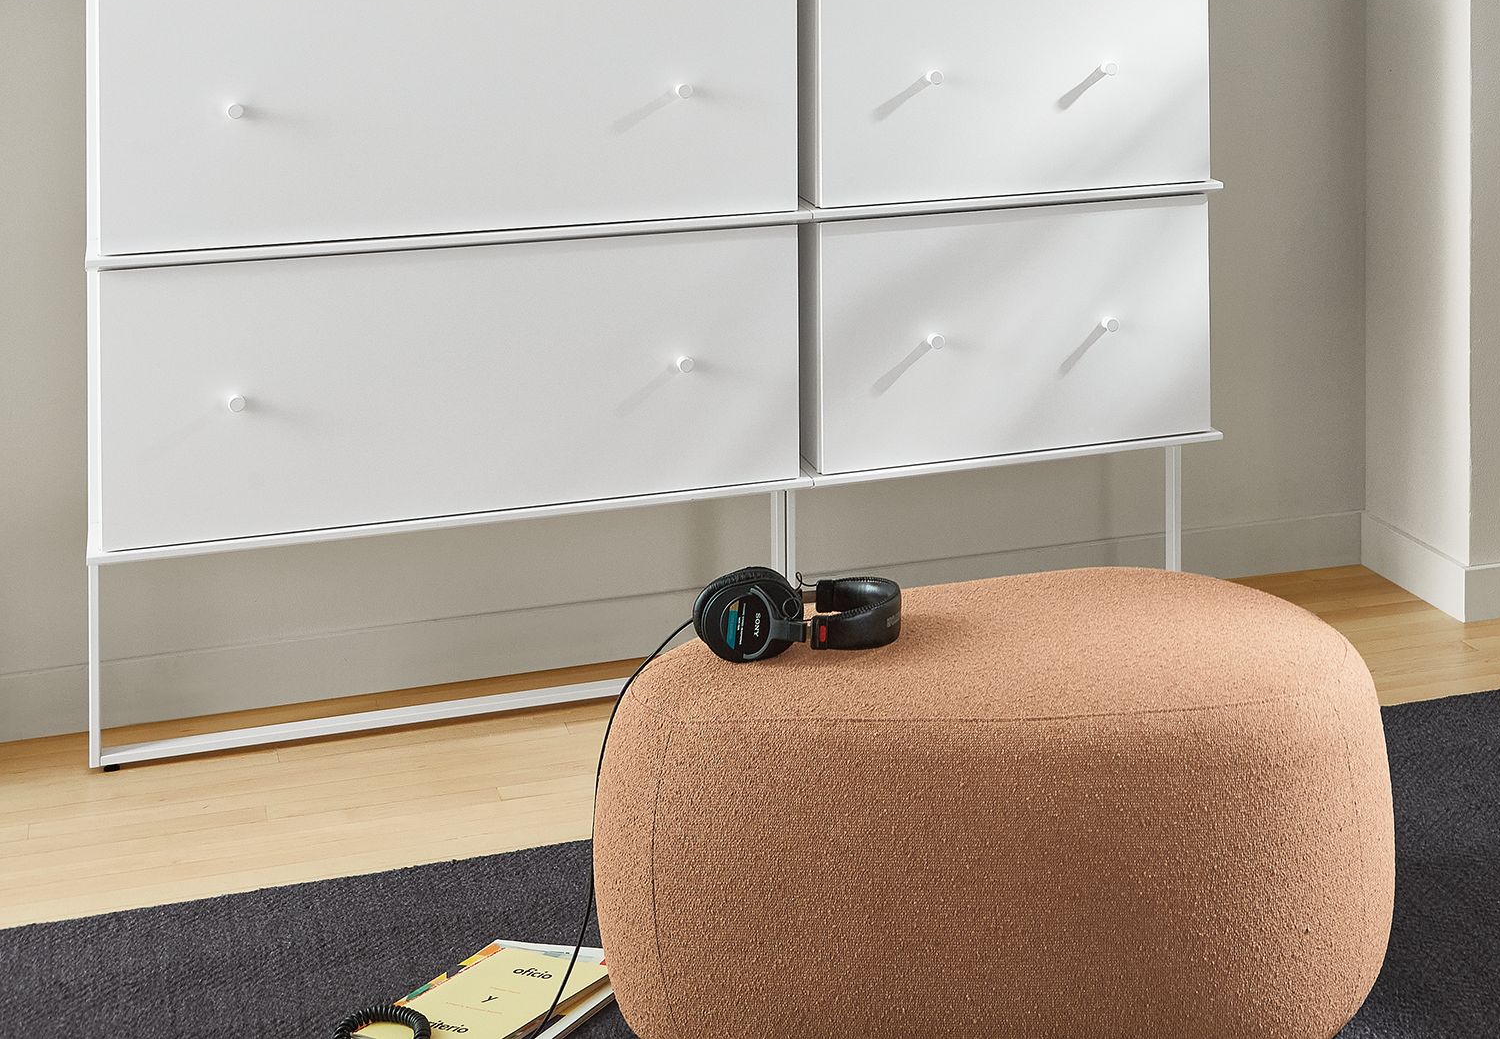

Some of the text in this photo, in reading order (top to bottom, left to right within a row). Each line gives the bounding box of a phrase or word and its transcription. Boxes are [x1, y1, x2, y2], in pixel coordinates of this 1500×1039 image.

[512, 966, 554, 981] oficio
[481, 994, 499, 1003] y
[429, 1020, 469, 1034] riterio
